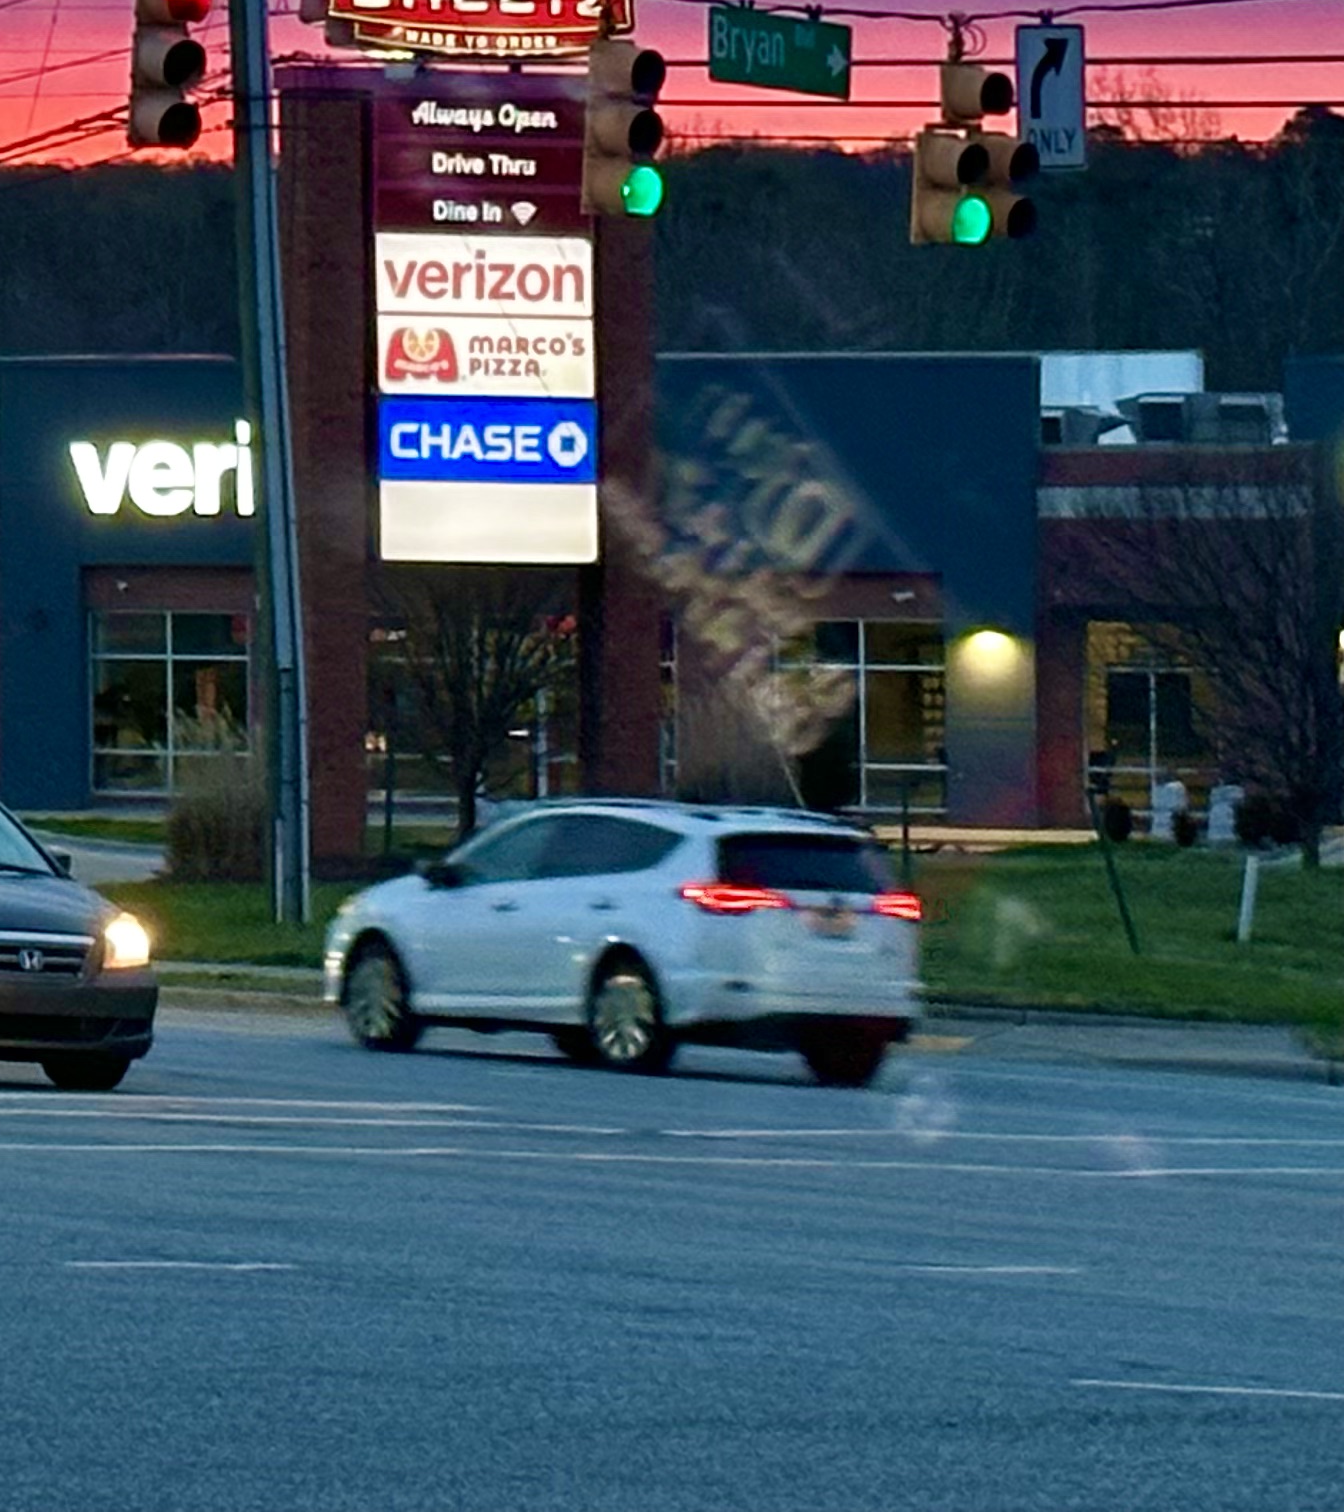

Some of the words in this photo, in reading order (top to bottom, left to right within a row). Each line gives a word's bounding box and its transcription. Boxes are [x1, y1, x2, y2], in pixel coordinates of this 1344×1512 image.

[712, 14, 785, 74] Bryan
[412, 100, 495, 133] Always
[498, 103, 558, 134] Open
[432, 151, 485, 175] Drive
[488, 153, 537, 177] Thru
[433, 199, 479, 222] Dine
[482, 201, 503, 223] In
[384, 249, 585, 302] verizon
[469, 331, 587, 356] MARCO'S
[469, 357, 541, 377] PIZZA
[390, 422, 543, 462] CHASE
